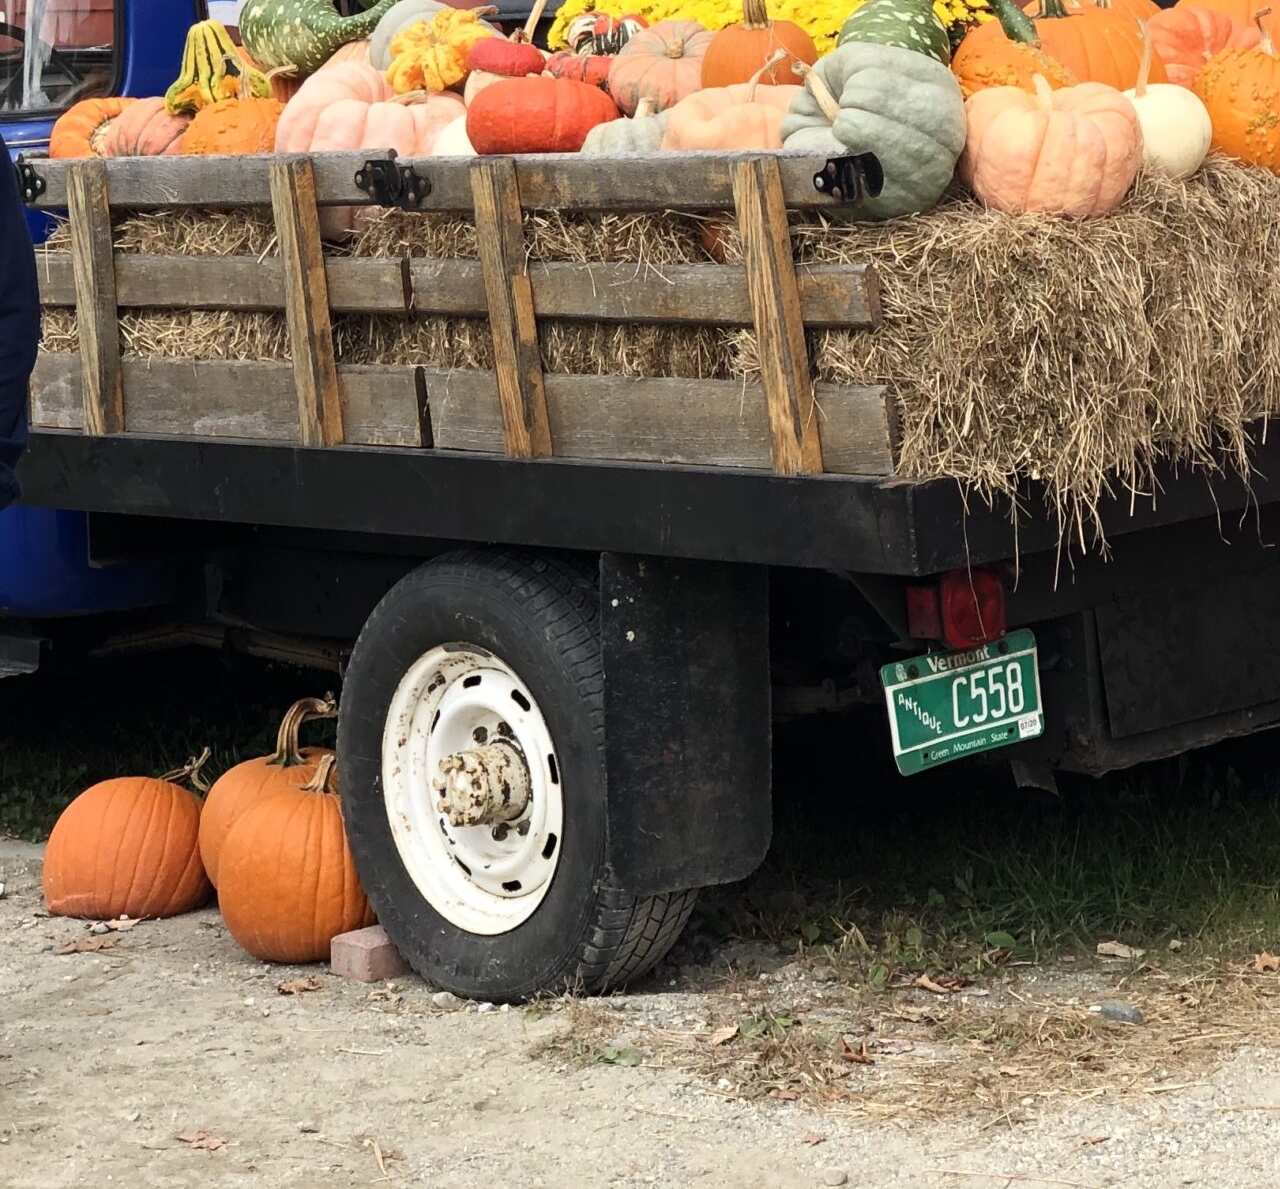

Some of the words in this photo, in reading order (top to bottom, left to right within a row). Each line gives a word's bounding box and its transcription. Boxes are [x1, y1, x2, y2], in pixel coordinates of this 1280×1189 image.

[927, 645, 990, 673] Vermont
[952, 662, 1024, 728] C558
[899, 693, 942, 734] ANTIQUE
[931, 747, 950, 760] Green
[953, 736, 987, 752] Mountain
[991, 728, 1008, 743] State
